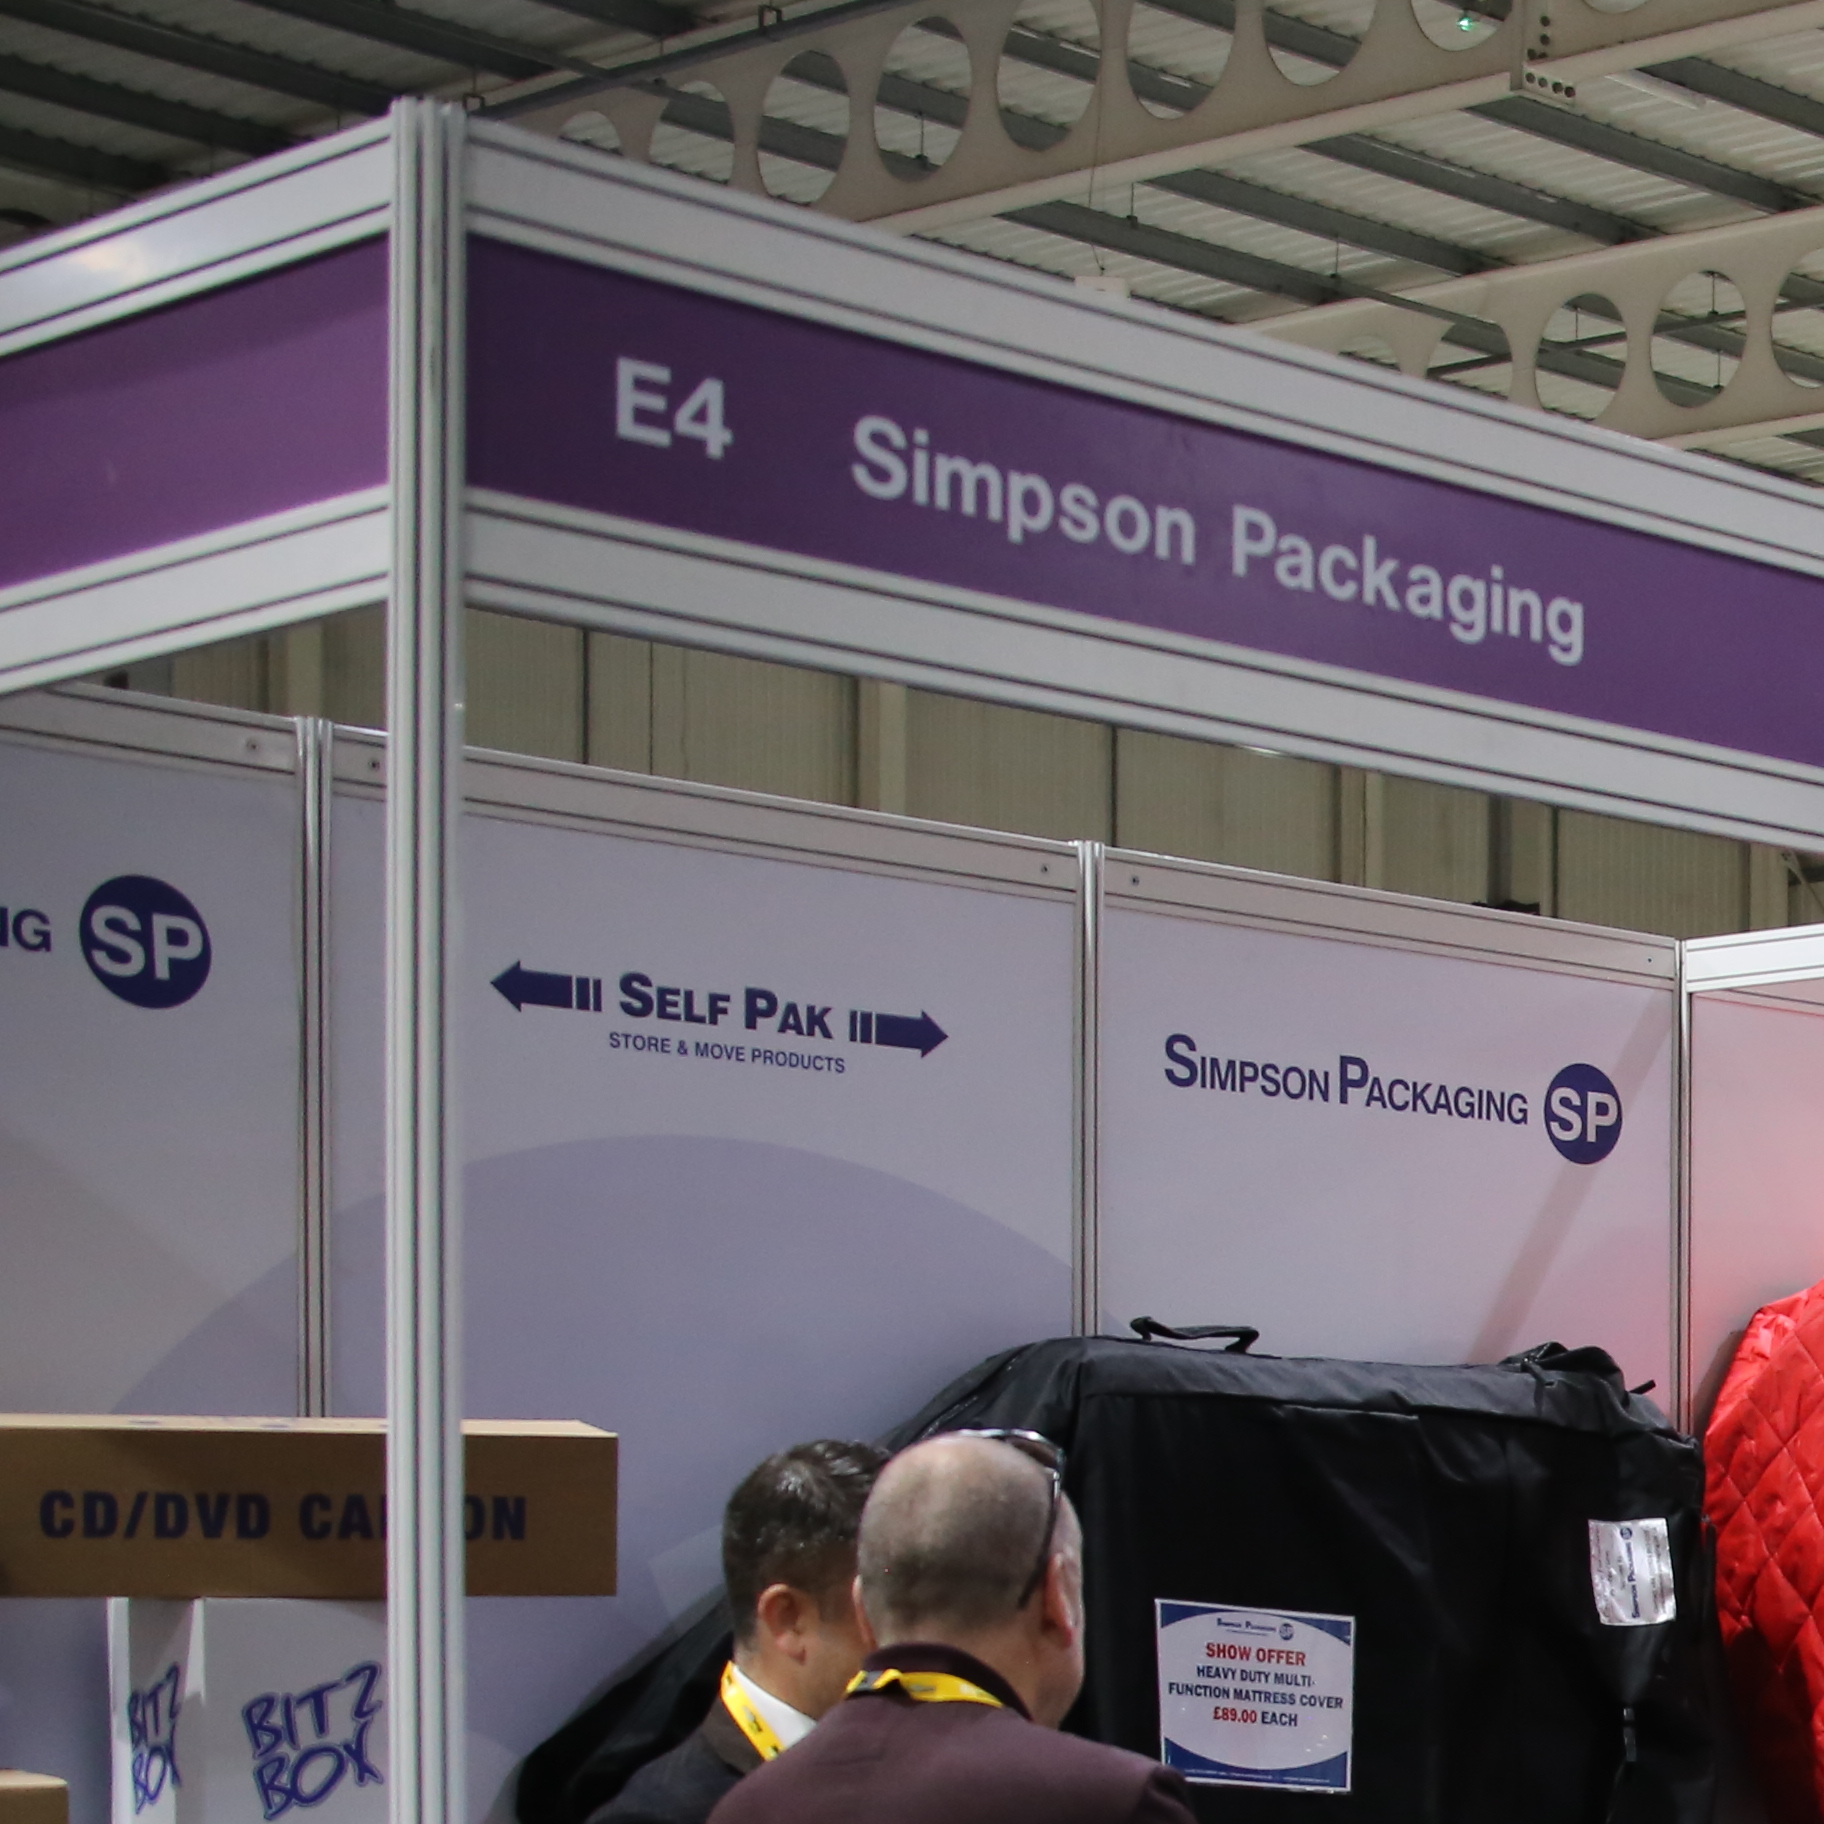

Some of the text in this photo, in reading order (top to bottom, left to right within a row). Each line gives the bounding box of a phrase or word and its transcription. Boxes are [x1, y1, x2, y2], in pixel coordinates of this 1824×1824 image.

[616, 355, 734, 460] E4
[851, 414, 1585, 666] Simpson Packaging
[89, 904, 205, 982] SP
[617, 972, 834, 1042] SELF PAK
[608, 1030, 847, 1075] STORE & MOVE PRODUCTS
[1163, 1032, 1621, 1145] SIMPSON PACKAGING SP
[38, 1490, 528, 1541] CD/DVD CAON
[1196, 1665, 1238, 1681] HEAVY
[1240, 1669, 1271, 1684] DUTY
[1205, 1642, 1307, 1667] SHOW OFFER
[1168, 1682, 1344, 1709] FUNCTION MATTRESS COVER
[1213, 1706, 1299, 1727] £89.00 EACH
